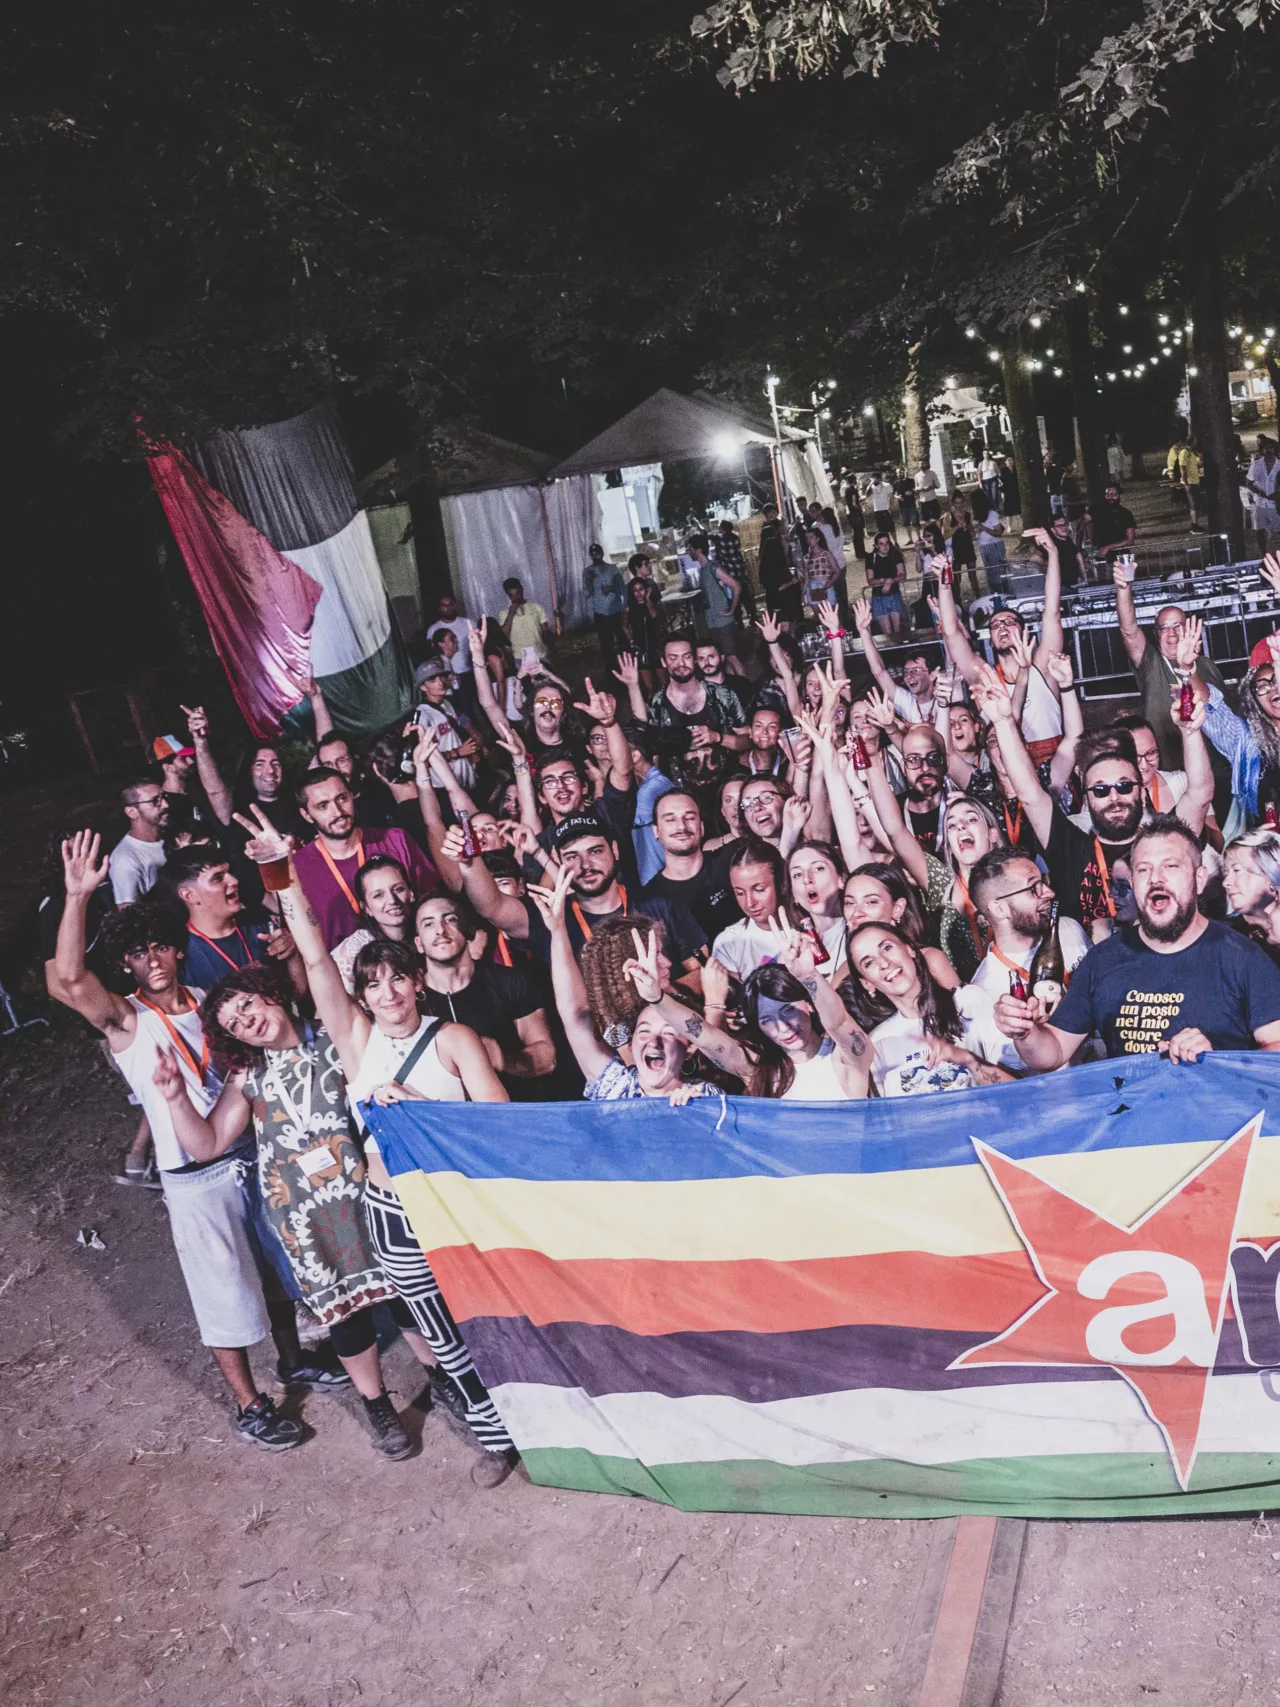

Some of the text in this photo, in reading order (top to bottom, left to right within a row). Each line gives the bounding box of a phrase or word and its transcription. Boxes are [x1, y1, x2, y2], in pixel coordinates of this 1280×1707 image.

[556, 817, 598, 837] CHE FATICA
[1126, 989, 1185, 1004] Conosco
[1120, 1004, 1180, 1018] un posto
[1115, 1015, 1170, 1029] nel mio
[1120, 1029, 1162, 1042] cuore
[1124, 1040, 1157, 1054] dove
